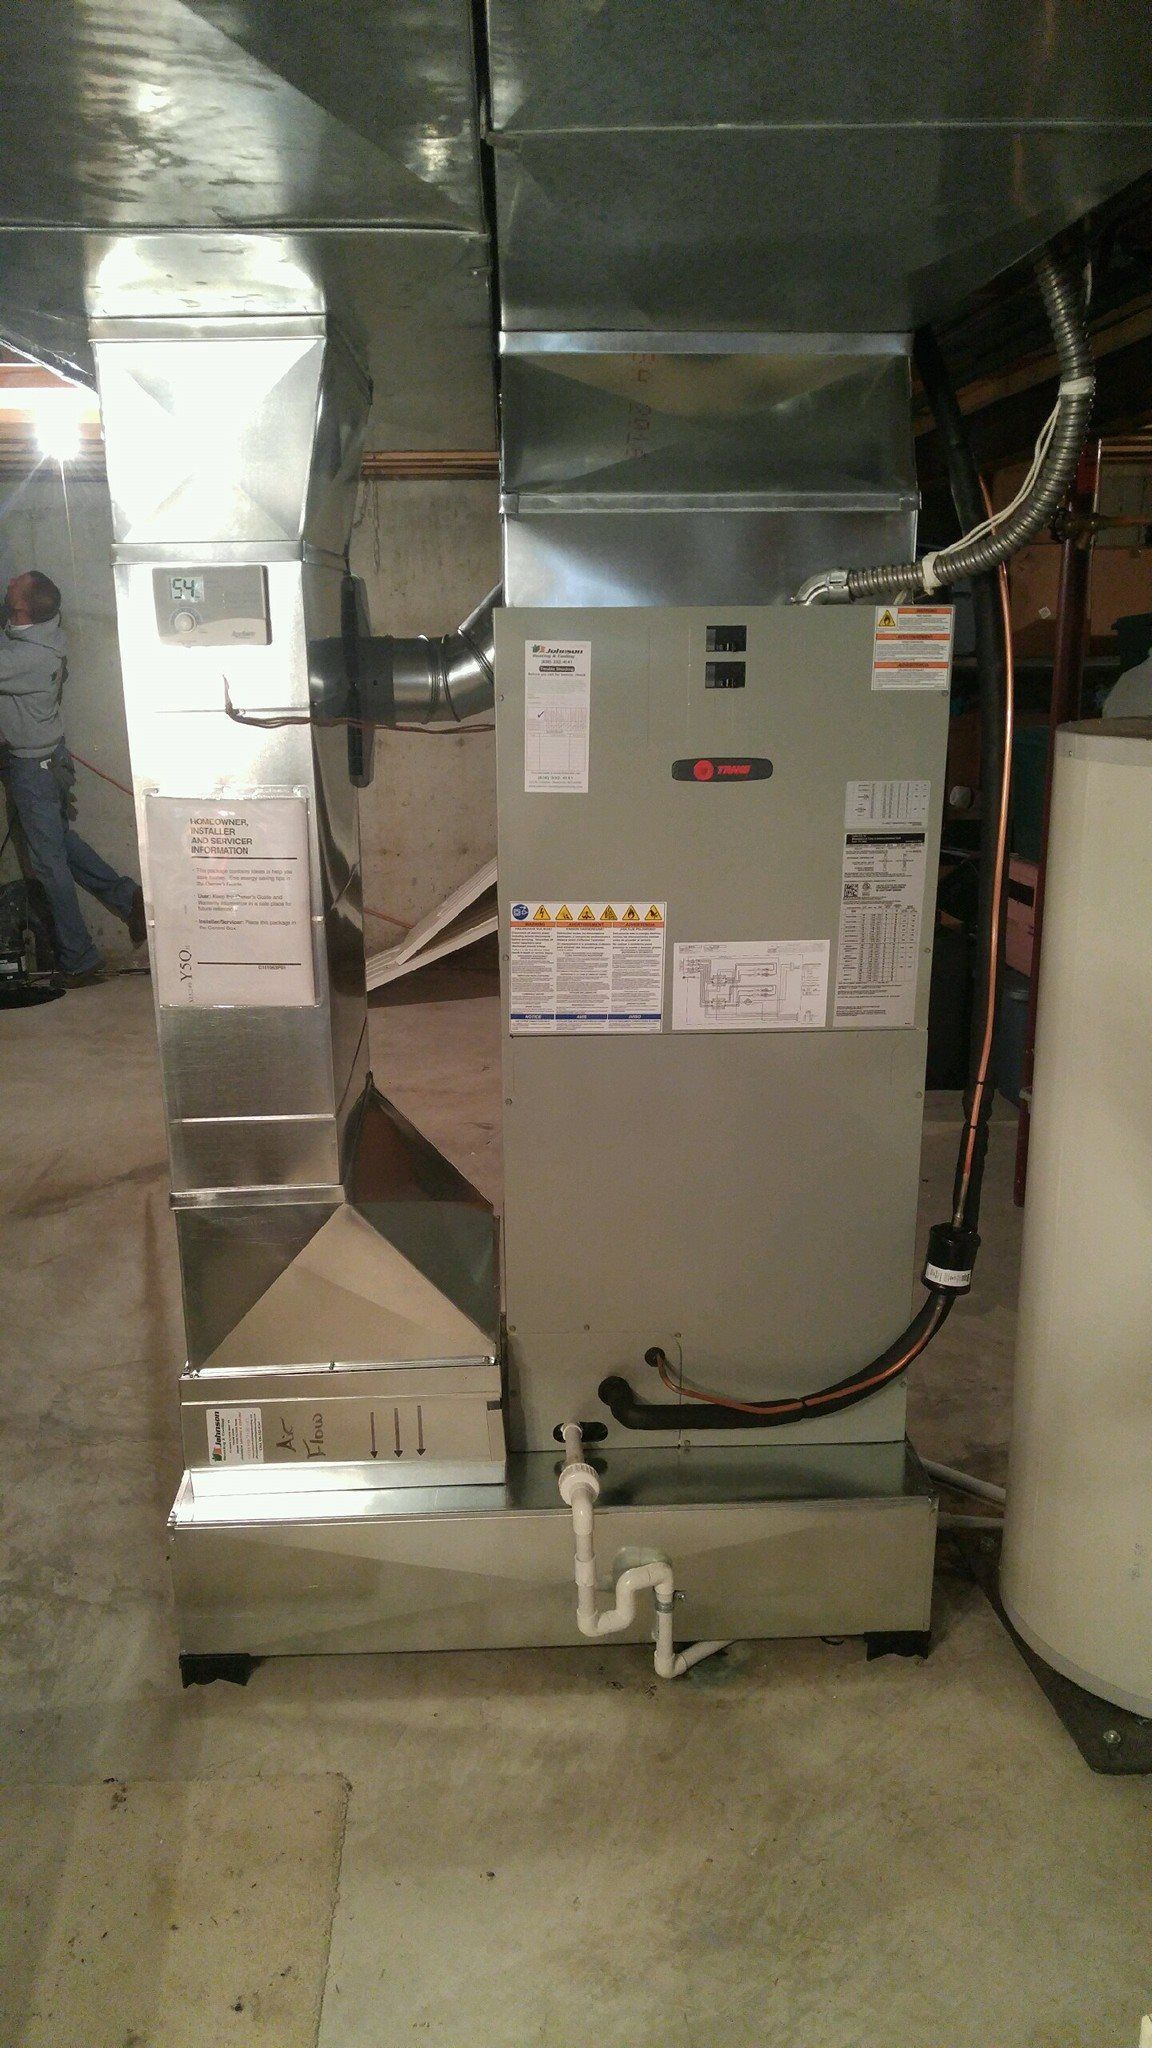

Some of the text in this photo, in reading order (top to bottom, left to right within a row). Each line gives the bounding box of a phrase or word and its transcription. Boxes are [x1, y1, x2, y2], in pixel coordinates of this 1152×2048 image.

[172, 578, 195, 599] 54
[189, 818, 249, 827] HOMEOWNER,
[190, 827, 236, 836] INSTALLER
[210, 837, 253, 845] SERVICER
[191, 846, 249, 855] INFORMATION
[214, 1411, 222, 1447] Johnson
